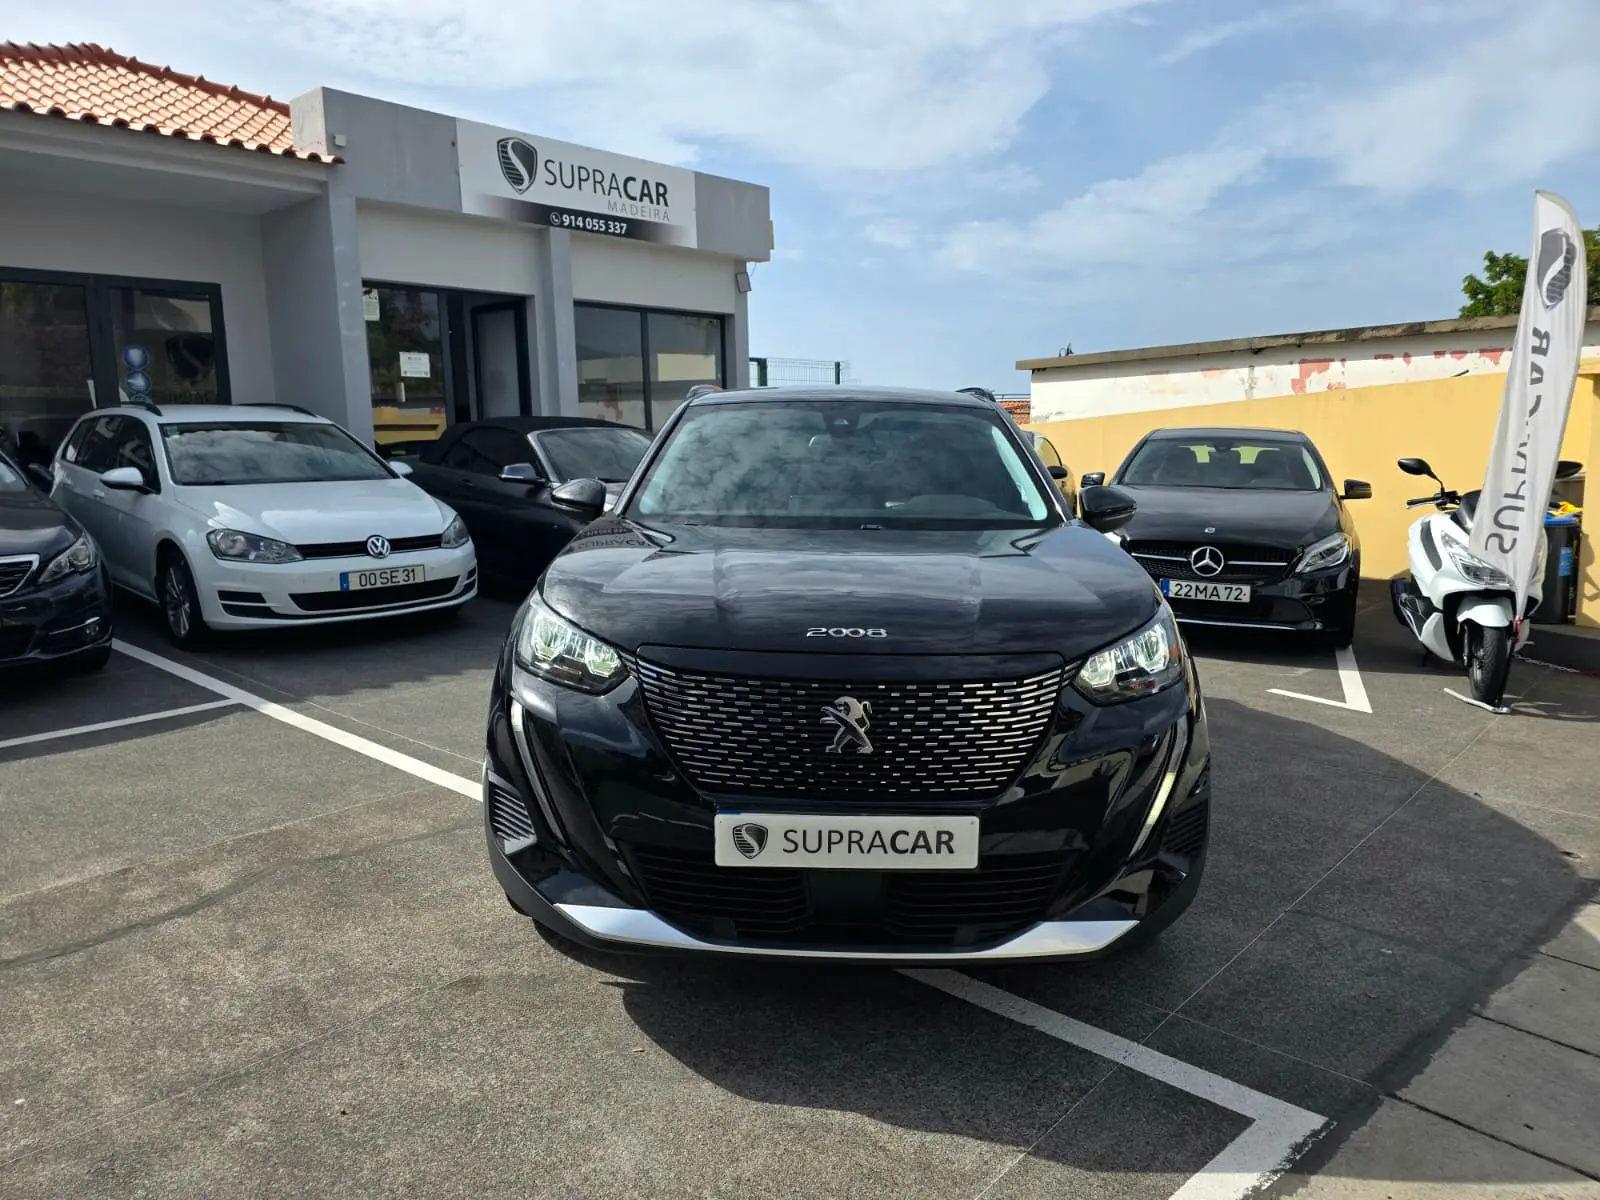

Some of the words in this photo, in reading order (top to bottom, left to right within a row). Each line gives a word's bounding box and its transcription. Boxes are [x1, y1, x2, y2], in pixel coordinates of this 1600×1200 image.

[543, 158, 669, 208] SUPRACAR
[607, 199, 670, 223] MADEIRA
[561, 213, 584, 229] 914
[585, 218, 606, 232] 055
[607, 221, 628, 235] 337
[805, 626, 889, 639] 2008
[781, 828, 956, 856] SUPRACAR
